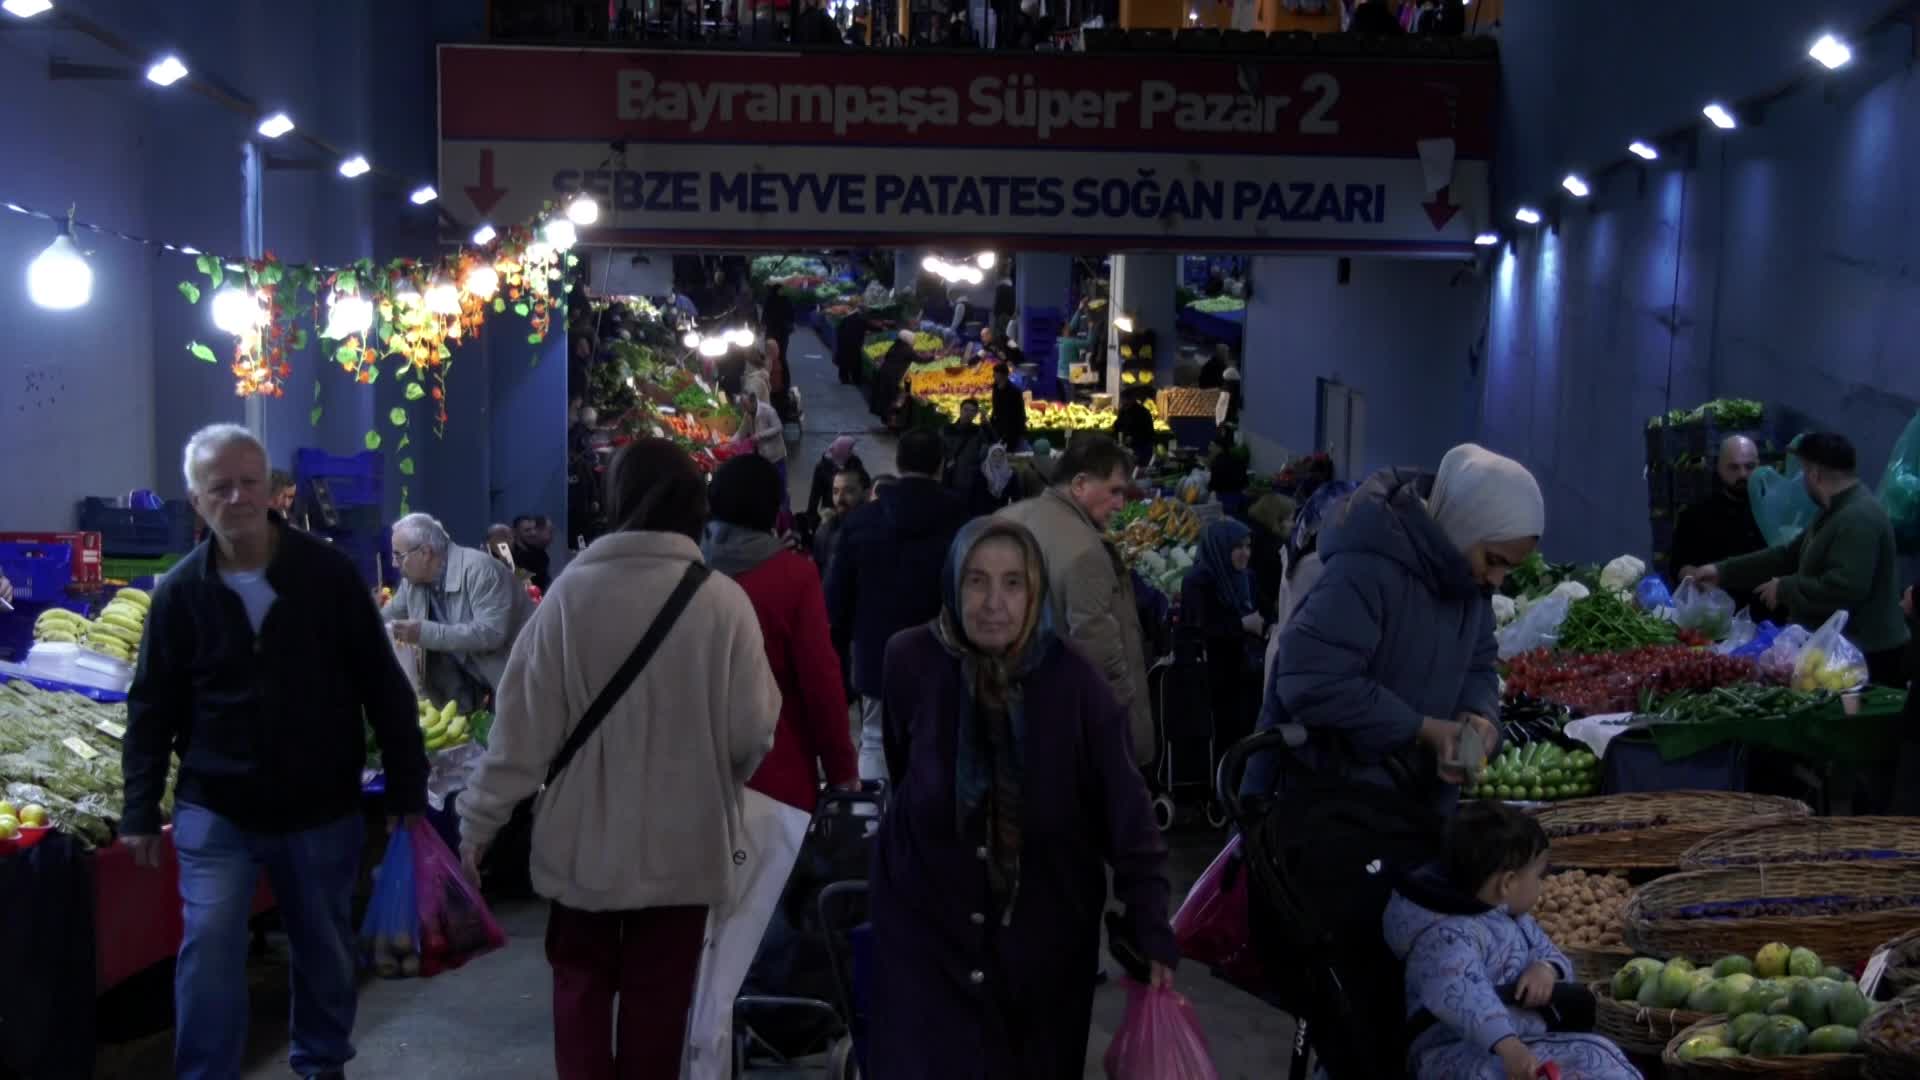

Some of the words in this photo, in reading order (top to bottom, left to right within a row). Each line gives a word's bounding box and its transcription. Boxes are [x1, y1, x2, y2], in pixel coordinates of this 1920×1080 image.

[616, 68, 959, 134] Bayrampaşa
[968, 74, 1133, 139] Süper
[1139, 78, 1292, 134] Pazar
[1299, 72, 1341, 136] 2
[711, 171, 866, 213] MEYVE
[877, 173, 1065, 218] PATATES
[1072, 168, 1222, 219] SOĞAN
[1233, 183, 1385, 223] PAZARI
